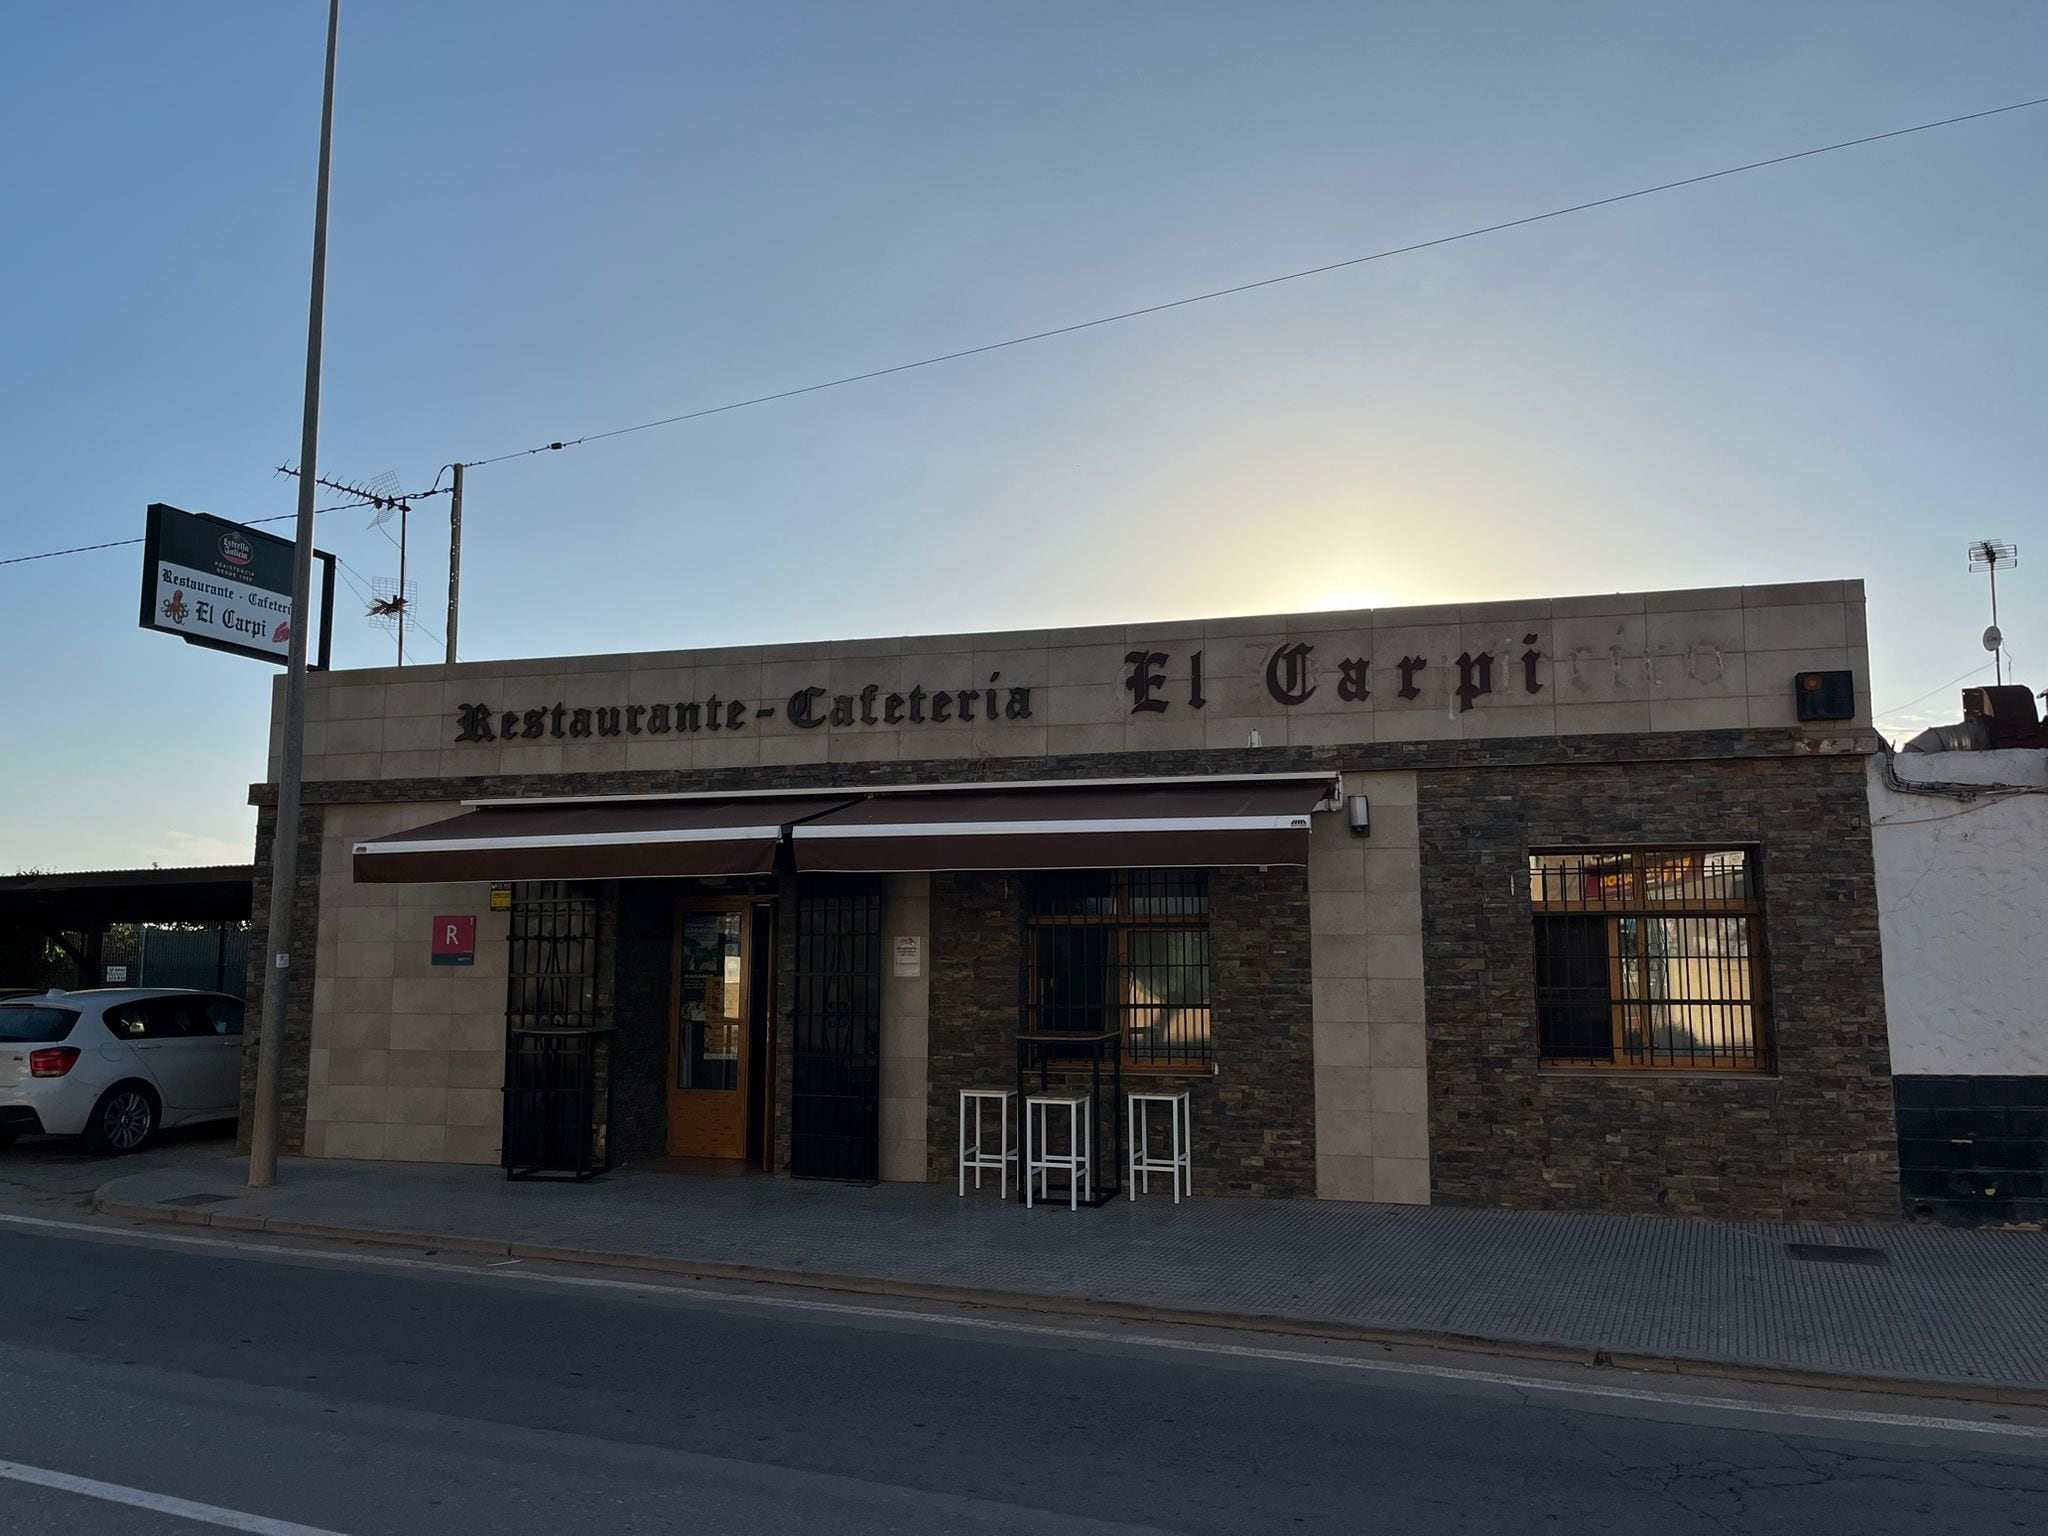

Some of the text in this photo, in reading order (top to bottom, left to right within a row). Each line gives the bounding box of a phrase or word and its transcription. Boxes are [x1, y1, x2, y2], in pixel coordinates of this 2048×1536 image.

[223, 537, 249, 552] Estrella
[224, 545, 248, 560] Galicia
[162, 568, 234, 600] Restaurante
[195, 600, 266, 638] El Carpi
[1125, 649, 1207, 715] El
[1265, 632, 1545, 714] Carpi
[446, 924, 459, 945] R
